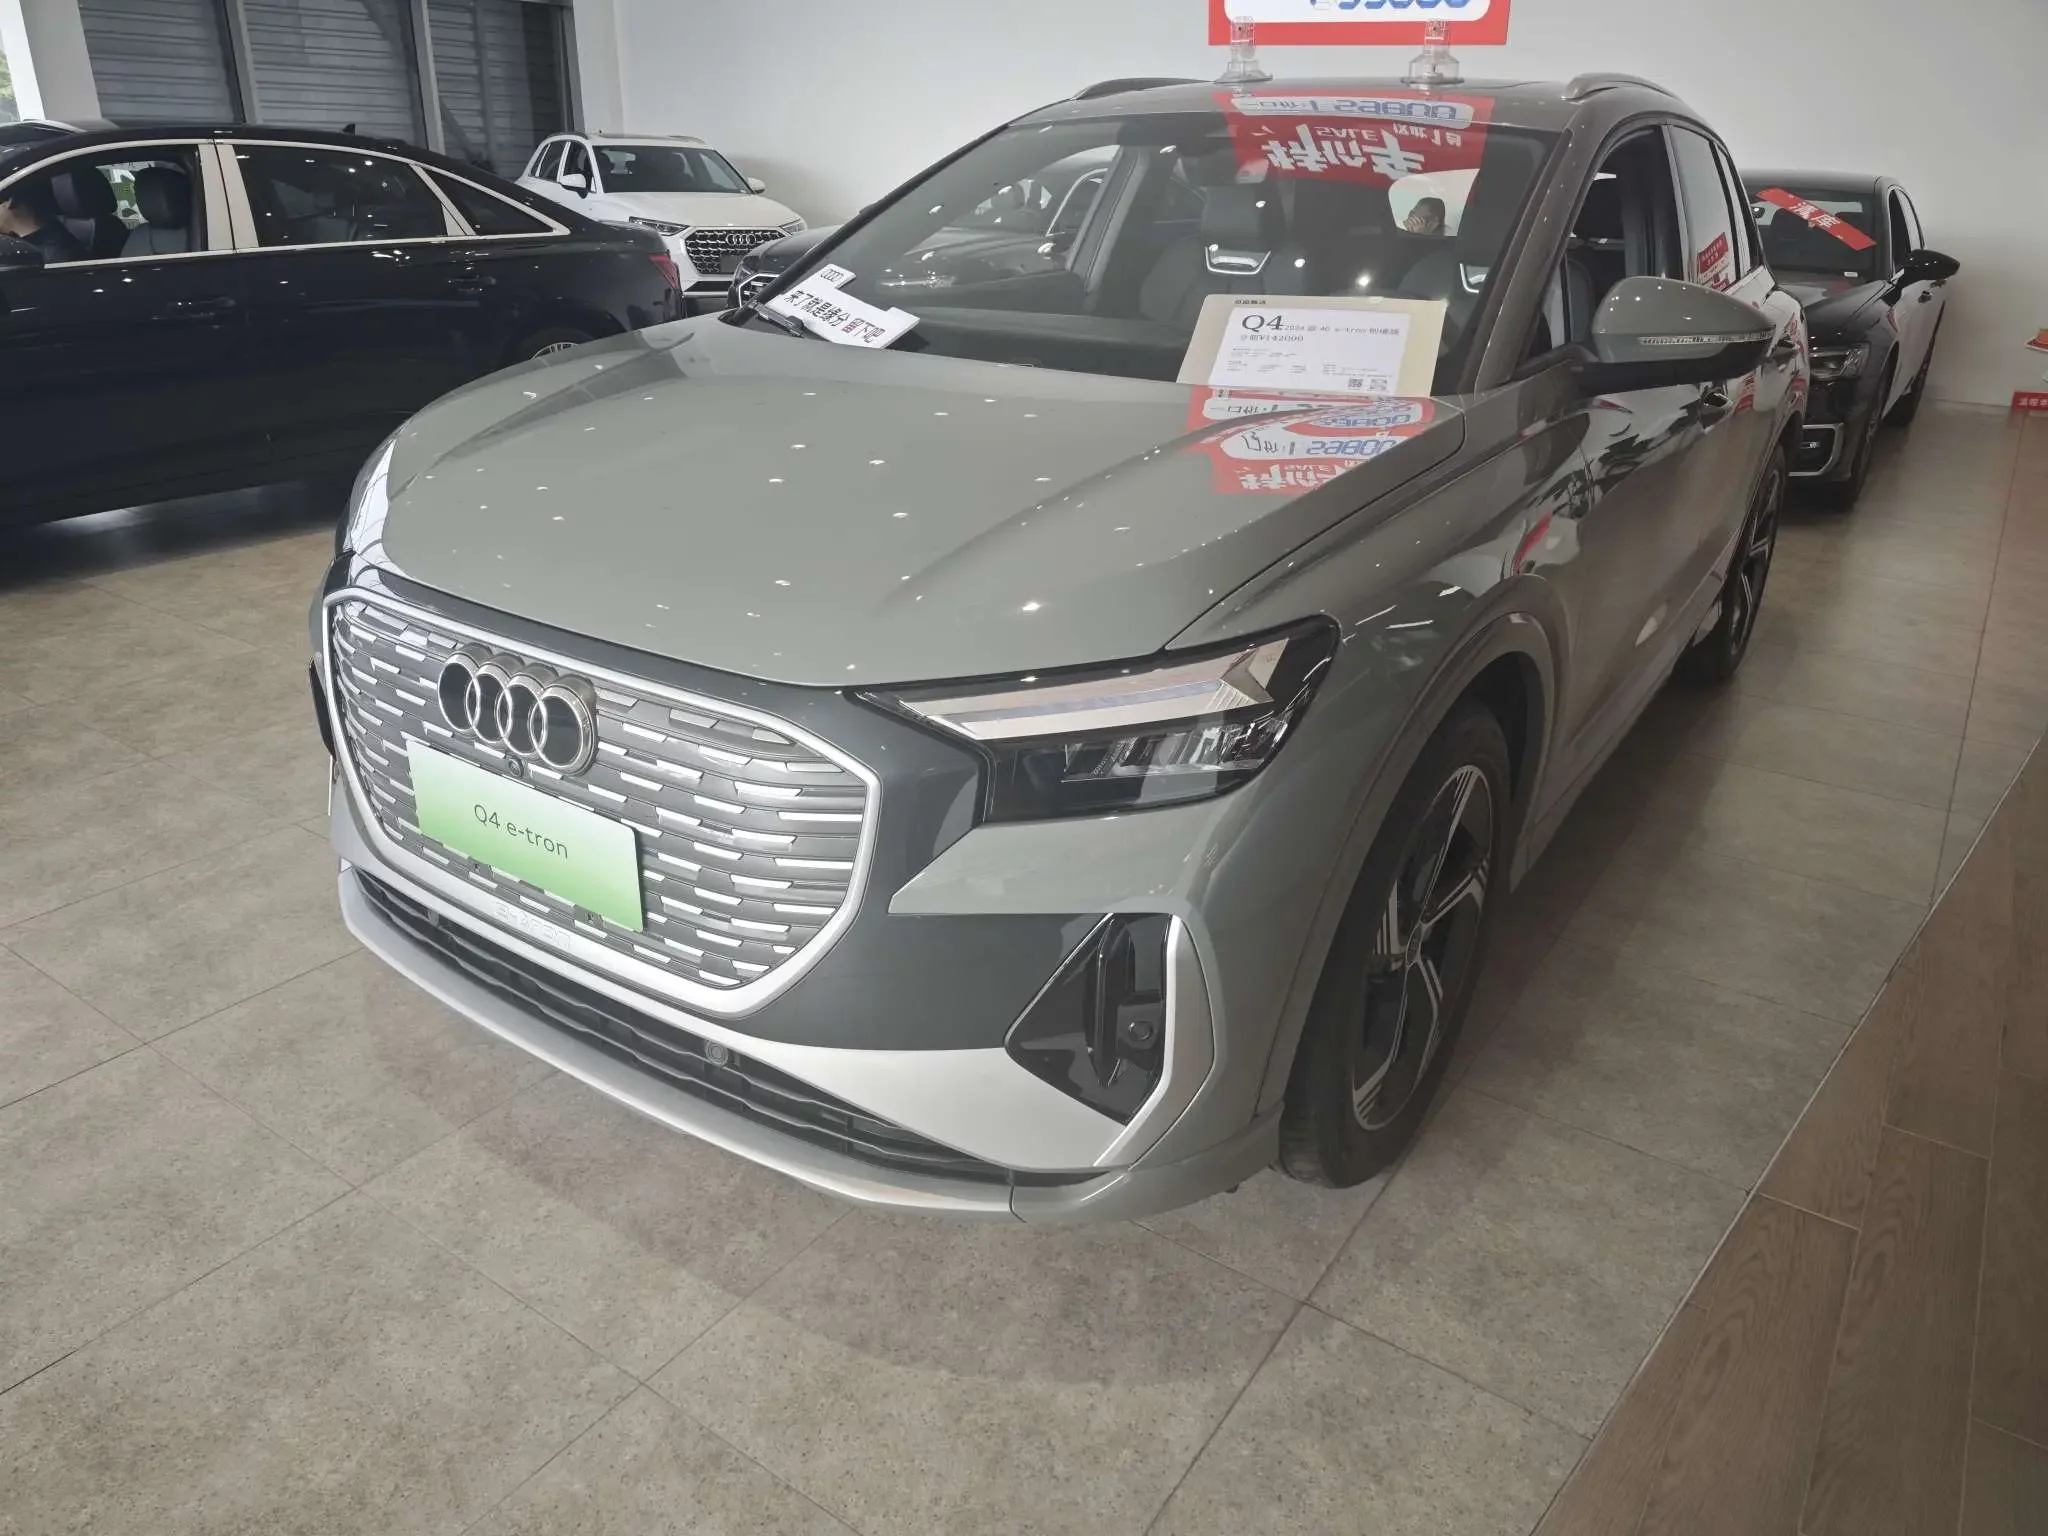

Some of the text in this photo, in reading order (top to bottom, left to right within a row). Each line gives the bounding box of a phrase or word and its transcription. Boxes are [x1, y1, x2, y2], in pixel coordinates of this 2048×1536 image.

[1241, 314, 1284, 333] Q4
[473, 803, 569, 859] Q4 e-tron
